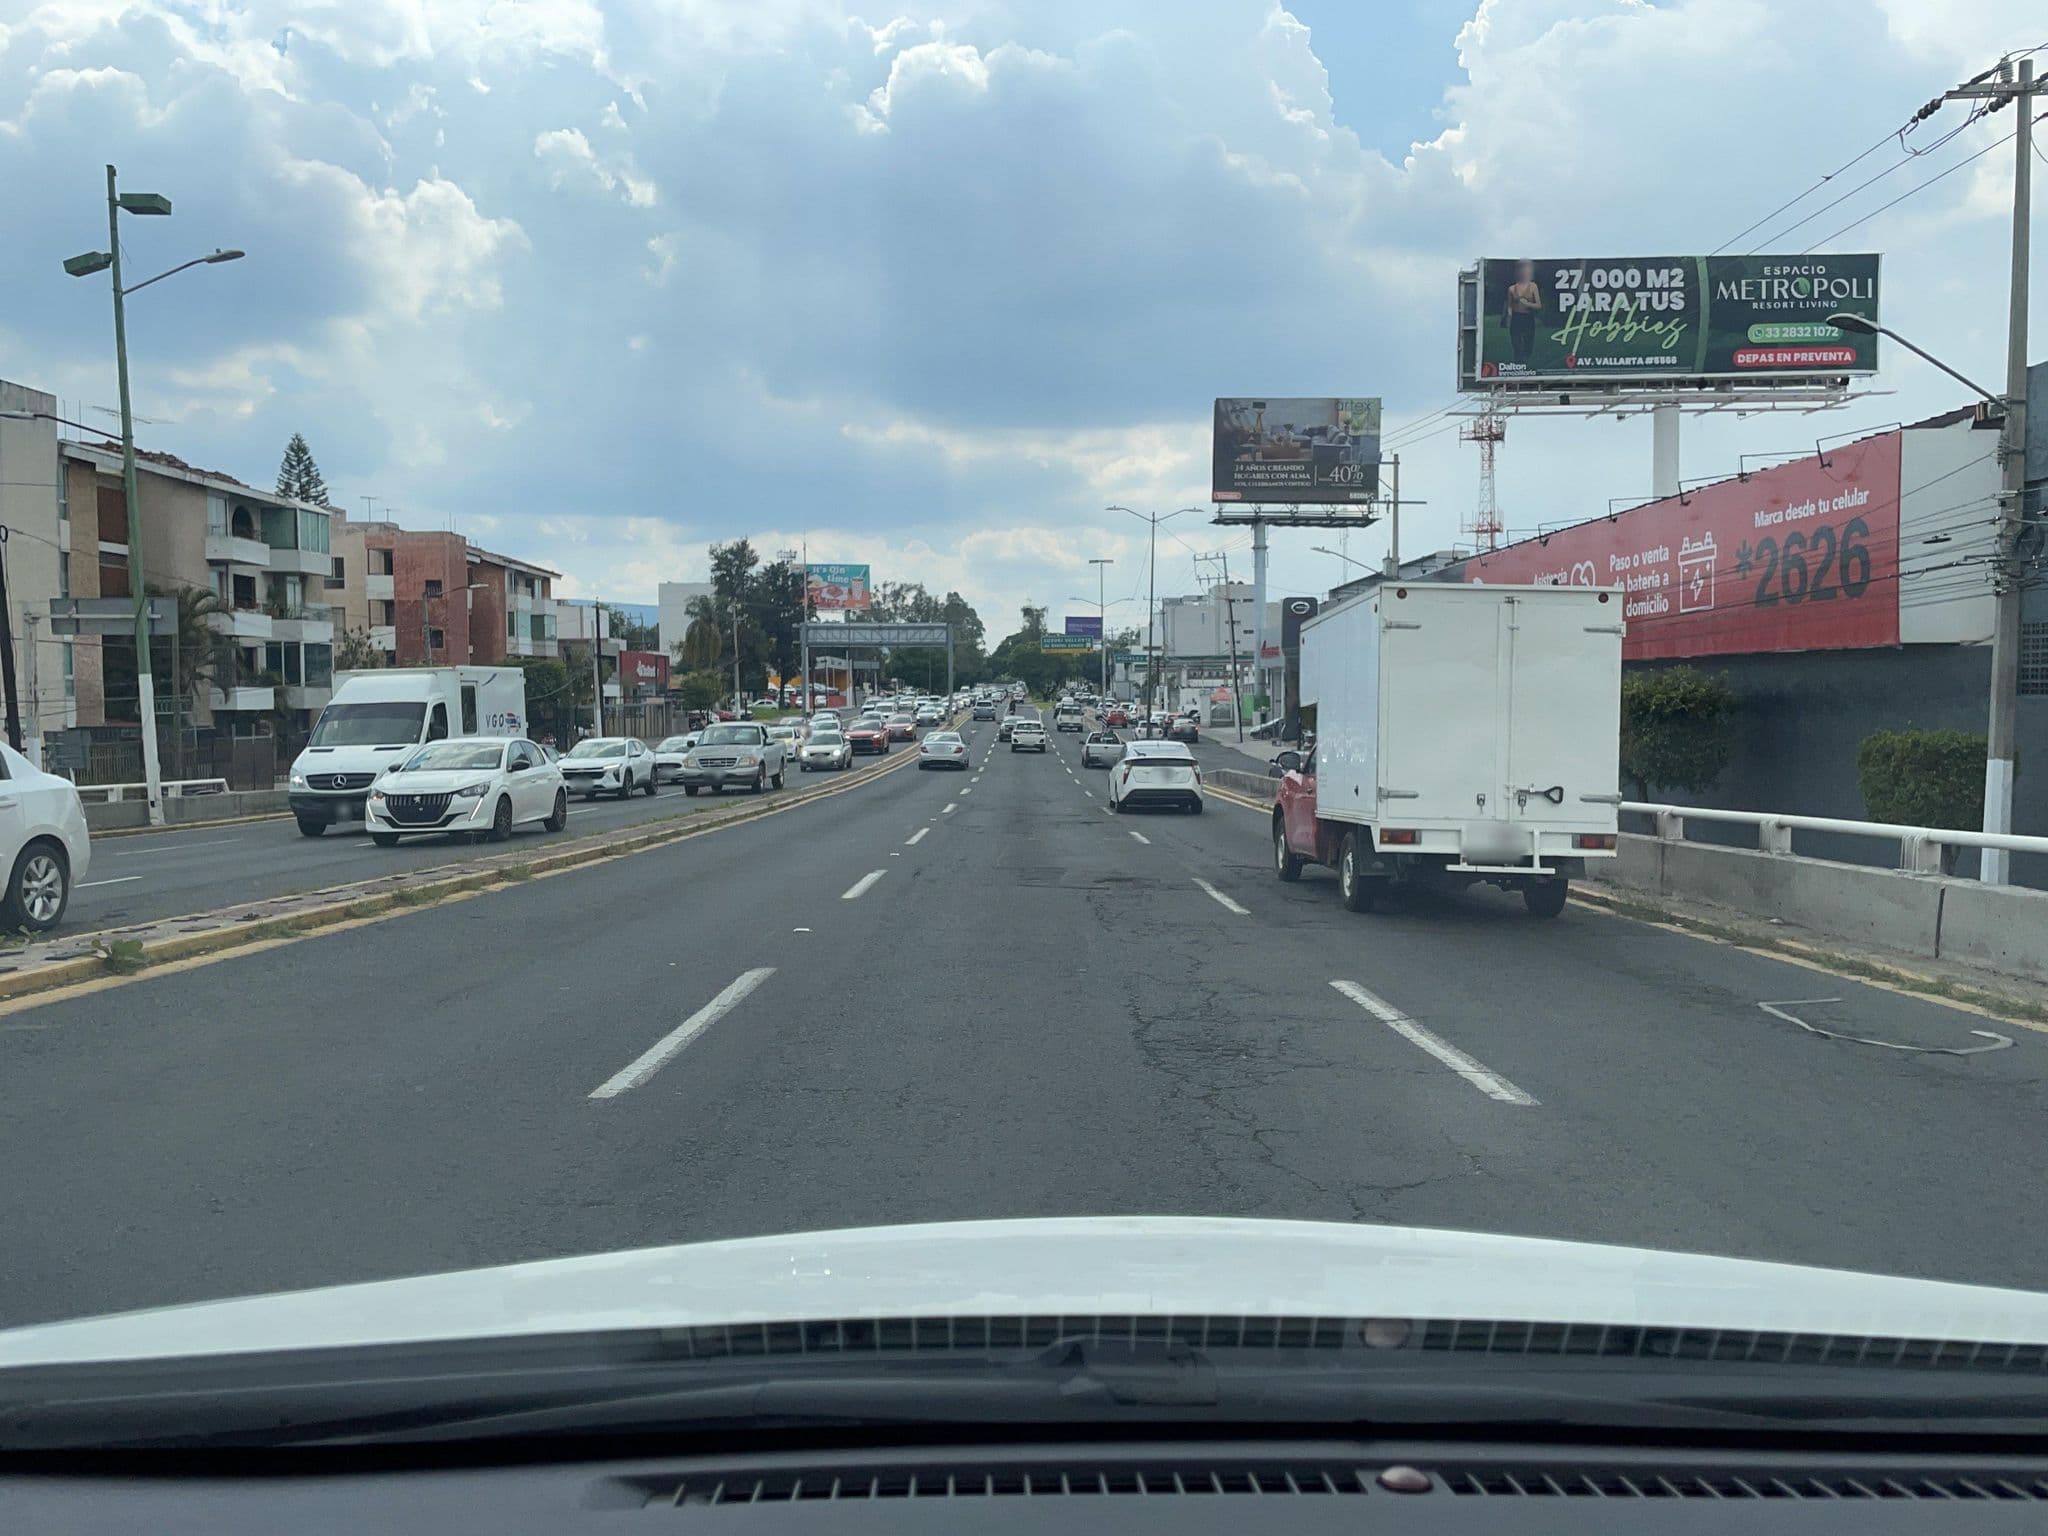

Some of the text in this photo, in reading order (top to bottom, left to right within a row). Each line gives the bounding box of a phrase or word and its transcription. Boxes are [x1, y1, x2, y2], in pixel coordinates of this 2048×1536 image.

[1555, 268, 1685, 292] 27,000 M2
[1764, 265, 1826, 276] ESPACIO
[1716, 277, 1873, 300] METROPOLI
[1559, 291, 1685, 312] PARA TUS
[1752, 301, 1838, 310] RESORT LIVING
[1551, 300, 1688, 356] Hobbies
[1765, 326, 1839, 338] 33 2832 1072
[1498, 362, 1527, 371] Dalton
[1577, 357, 1594, 366] AV.
[1596, 357, 1644, 366] VALLARTA
[1738, 352, 1852, 363] DEPAS EN PREVENTA
[1754, 487, 1870, 529] Marca desde tu celular
[1609, 545, 1669, 573] Paso o venta
[1626, 570, 1661, 593] batería
[1662, 572, 1669, 586] a
[1626, 592, 1669, 618] domicilio
